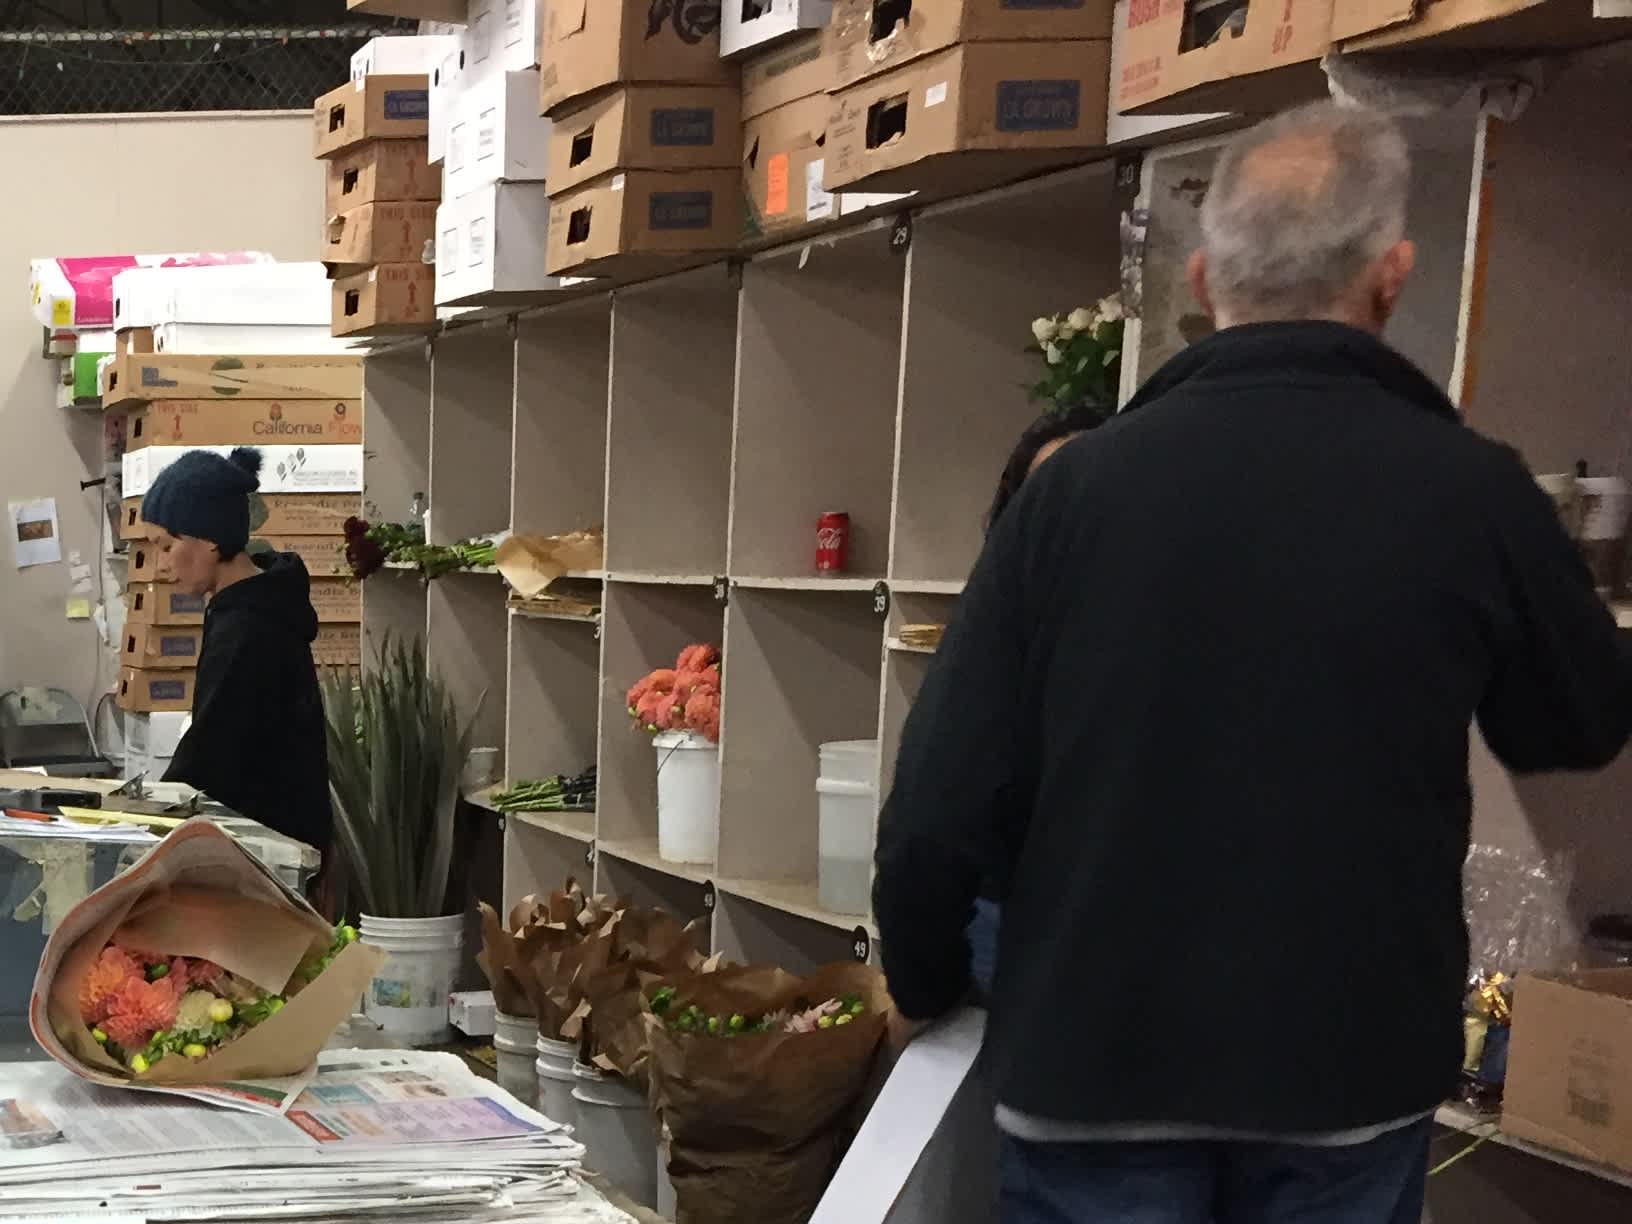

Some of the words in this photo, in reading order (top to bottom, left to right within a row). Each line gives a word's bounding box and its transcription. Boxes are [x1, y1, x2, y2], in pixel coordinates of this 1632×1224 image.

[1120, 163, 1134, 187] 30
[892, 226, 908, 245] 29
[253, 419, 323, 436] California
[874, 595, 886, 612] 39
